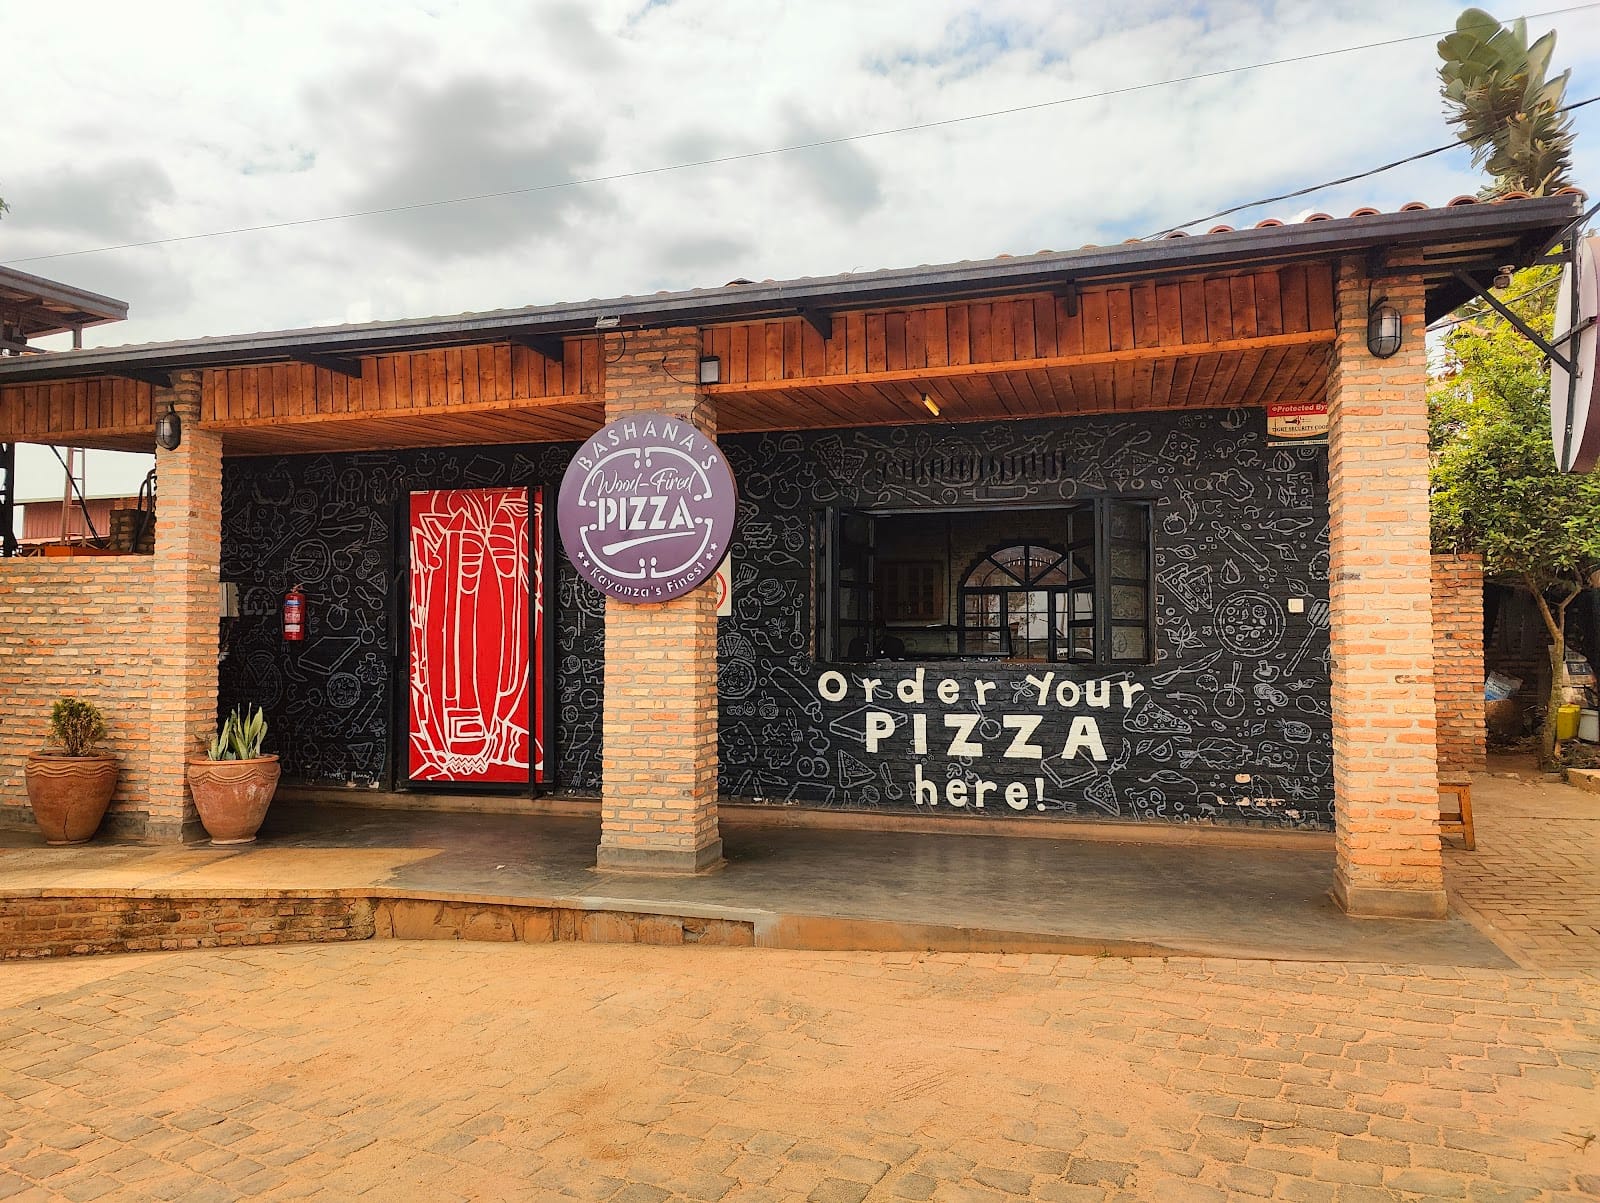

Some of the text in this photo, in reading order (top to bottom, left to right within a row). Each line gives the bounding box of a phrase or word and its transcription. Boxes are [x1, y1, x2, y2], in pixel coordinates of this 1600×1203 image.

[1277, 404, 1314, 412] Protected
[577, 421, 717, 471] BASHANA'S
[592, 467, 697, 496] Wood-Fired
[598, 496, 695, 531] PIZZA
[590, 561, 706, 597] Kayonza's Finest
[817, 667, 1145, 709] Order Your
[865, 711, 1108, 761] PIZZA
[914, 764, 1046, 812] here!
